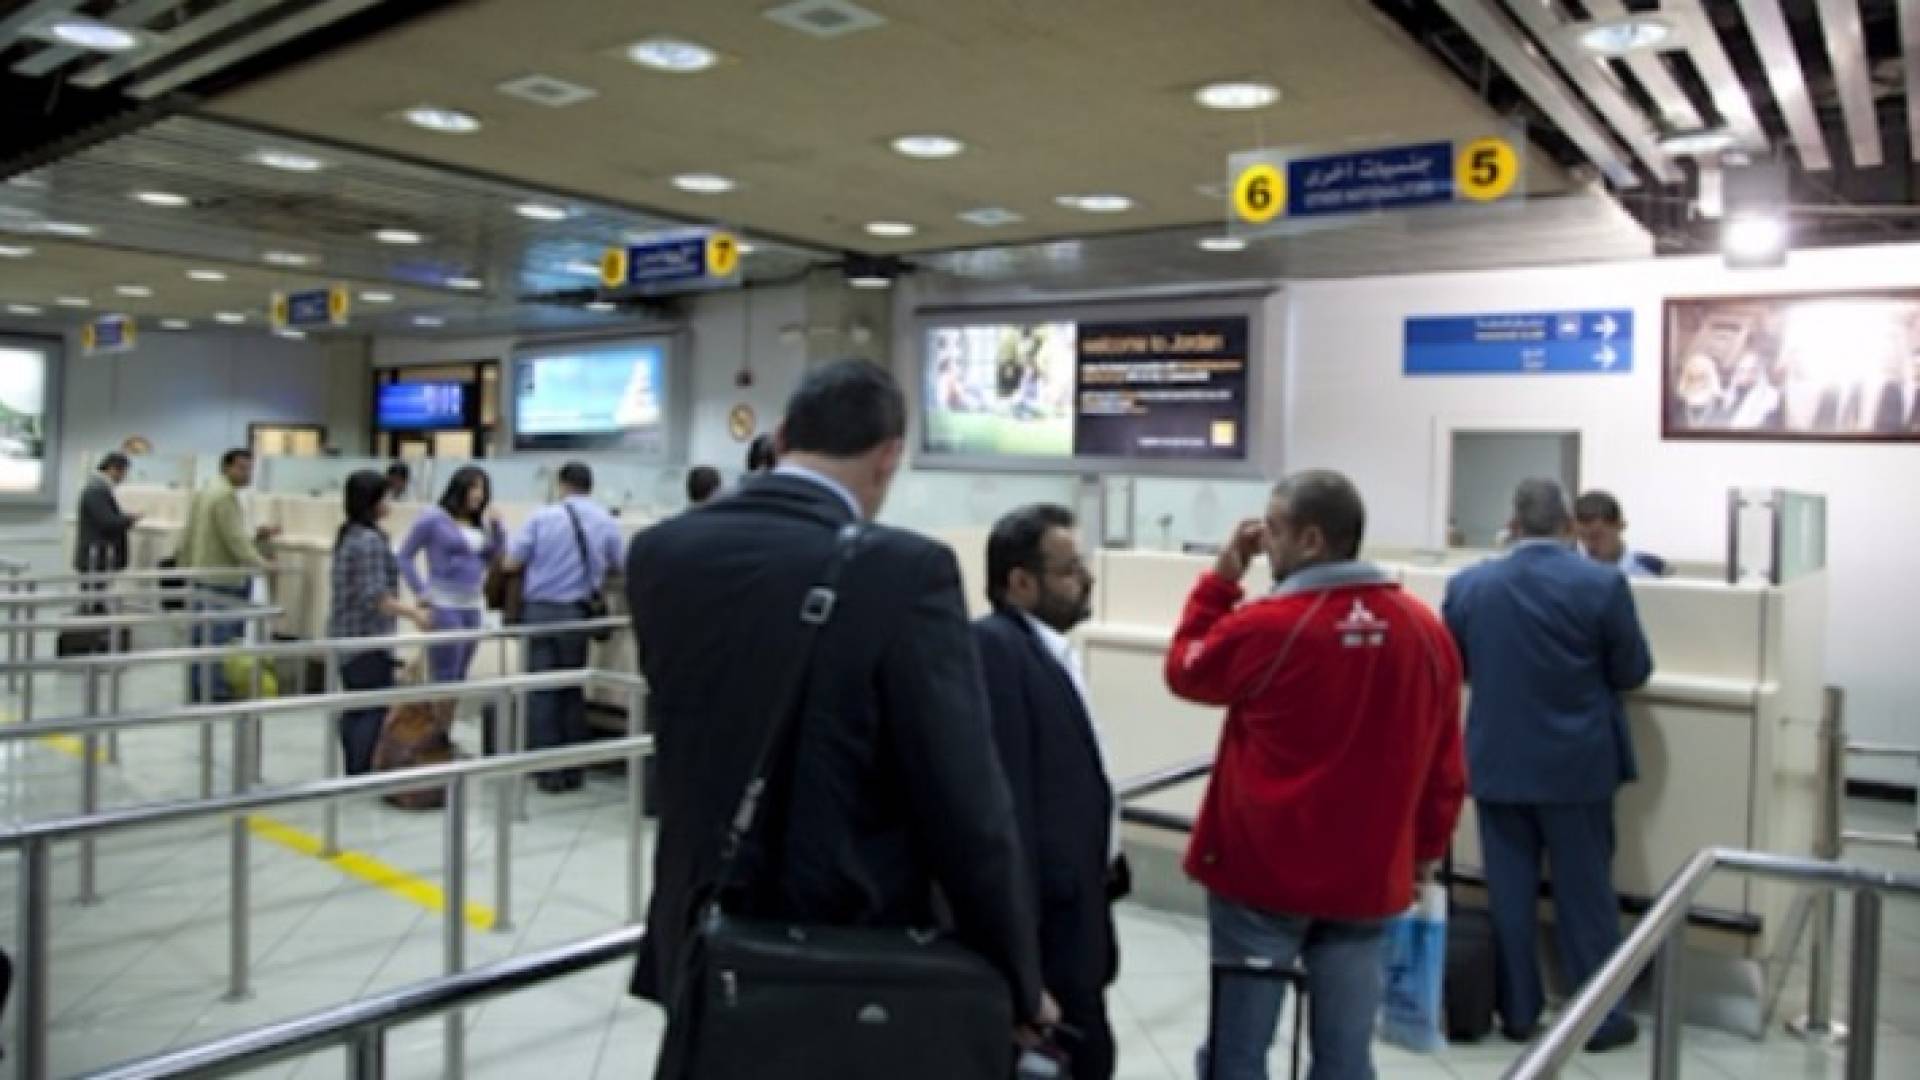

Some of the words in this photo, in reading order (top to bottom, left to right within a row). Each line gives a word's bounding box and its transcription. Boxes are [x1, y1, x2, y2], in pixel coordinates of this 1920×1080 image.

[1469, 148, 1499, 187] 5
[1245, 174, 1272, 211] 6
[714, 240, 731, 269] 7
